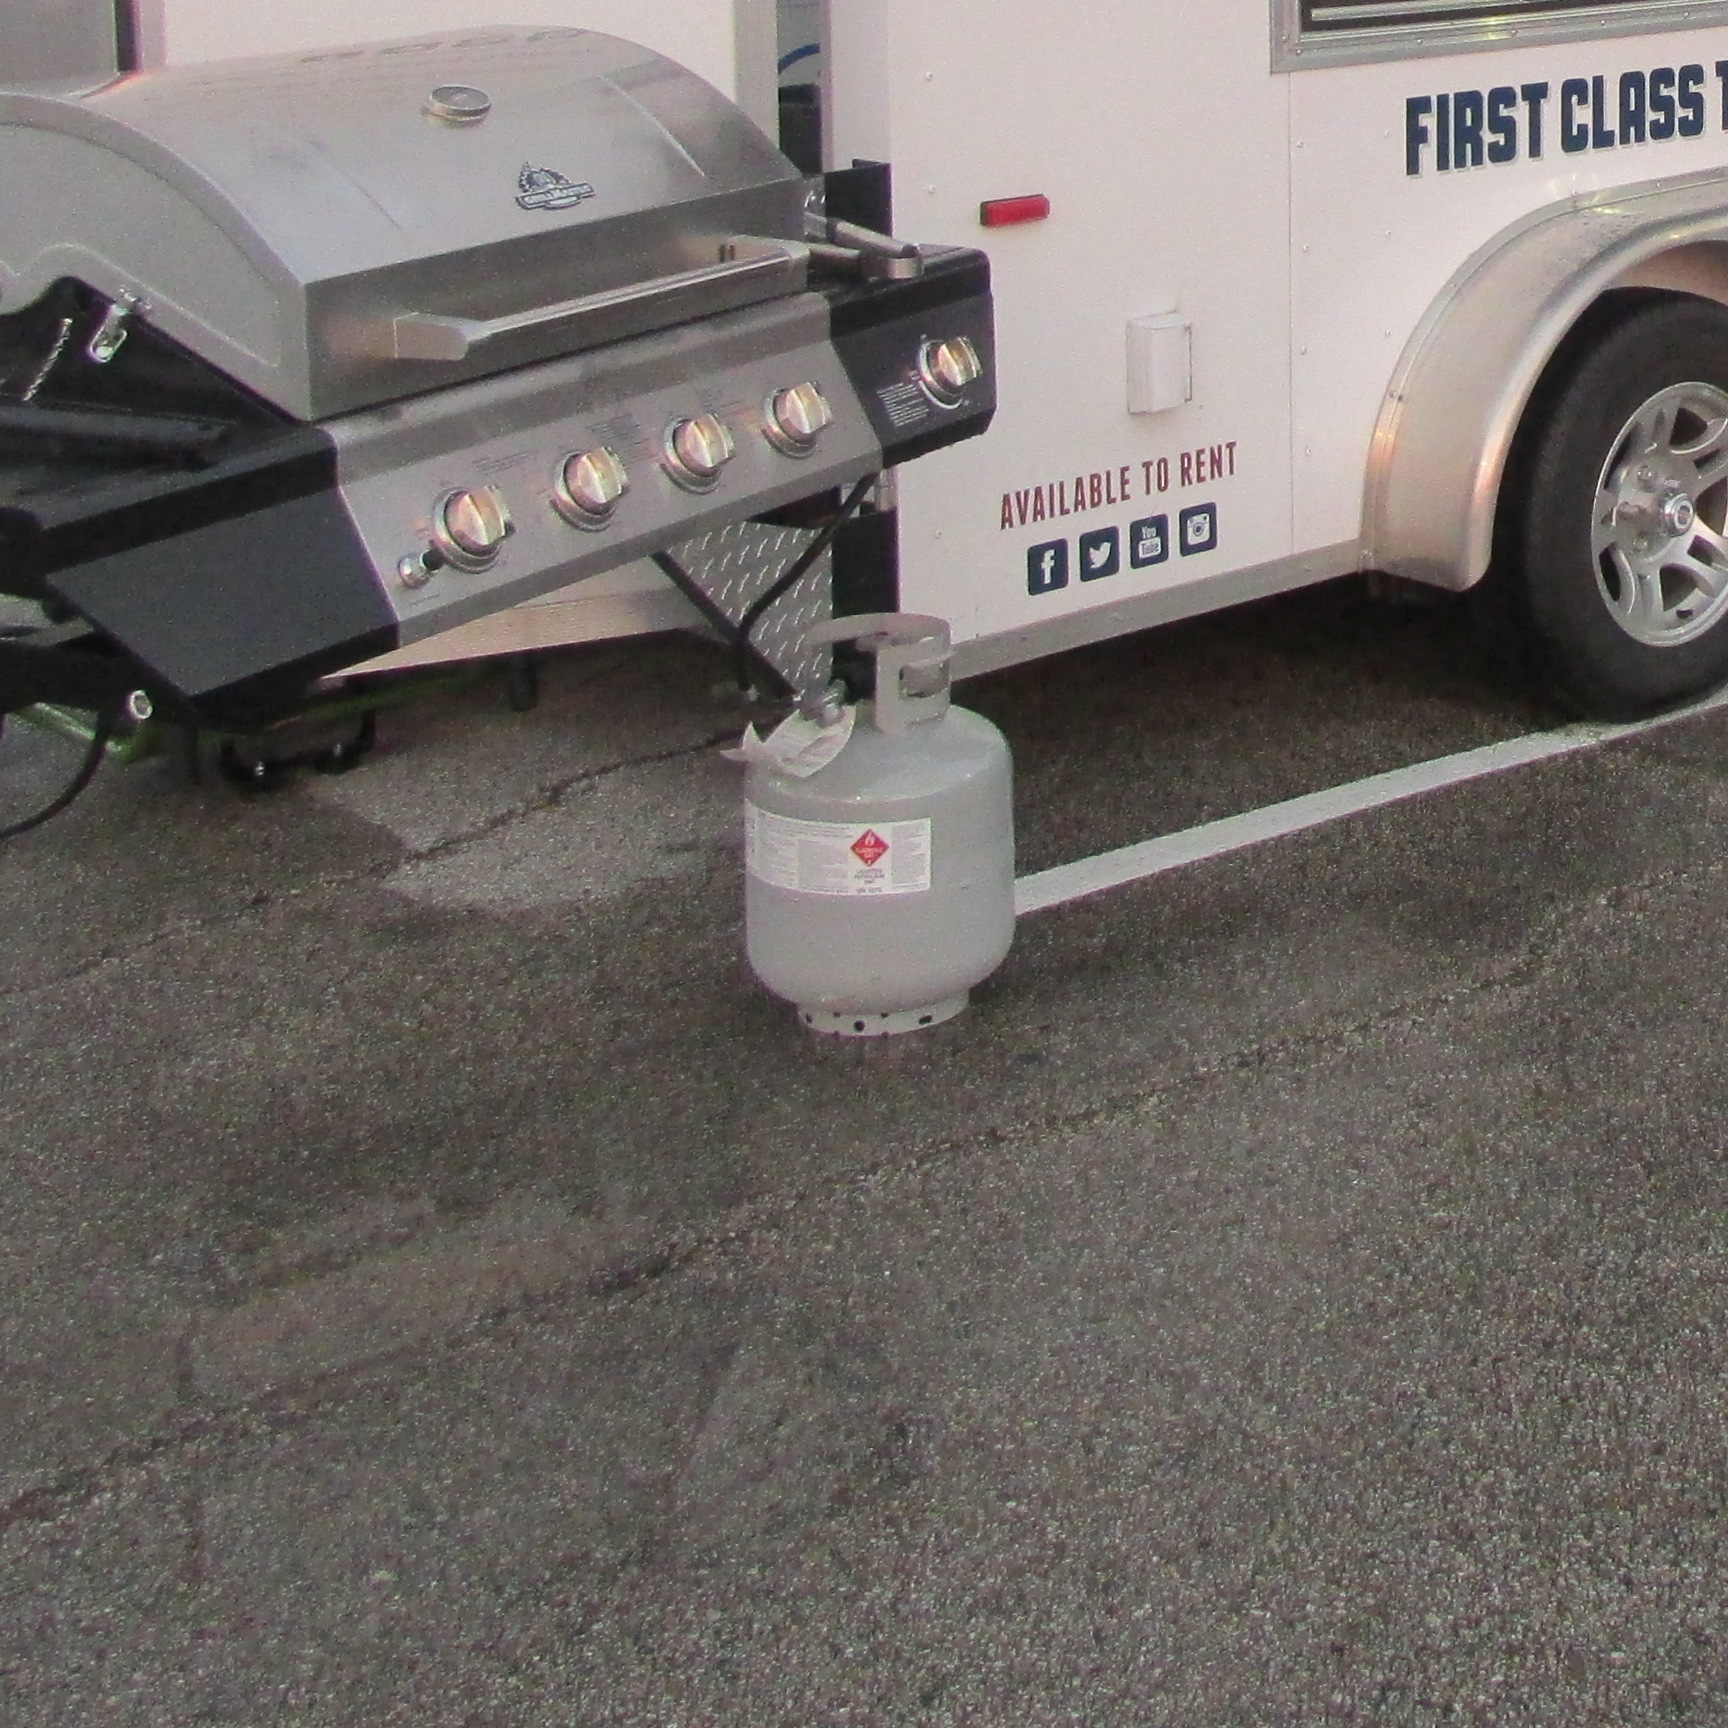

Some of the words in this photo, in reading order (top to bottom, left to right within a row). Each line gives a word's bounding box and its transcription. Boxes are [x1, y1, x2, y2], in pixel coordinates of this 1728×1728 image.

[1406, 81, 1549, 176] FIRST
[1561, 63, 1705, 153] CLASS
[1000, 465, 1131, 530] AVAILABLE
[1142, 457, 1169, 495] TO
[1180, 441, 1237, 487] RENT
